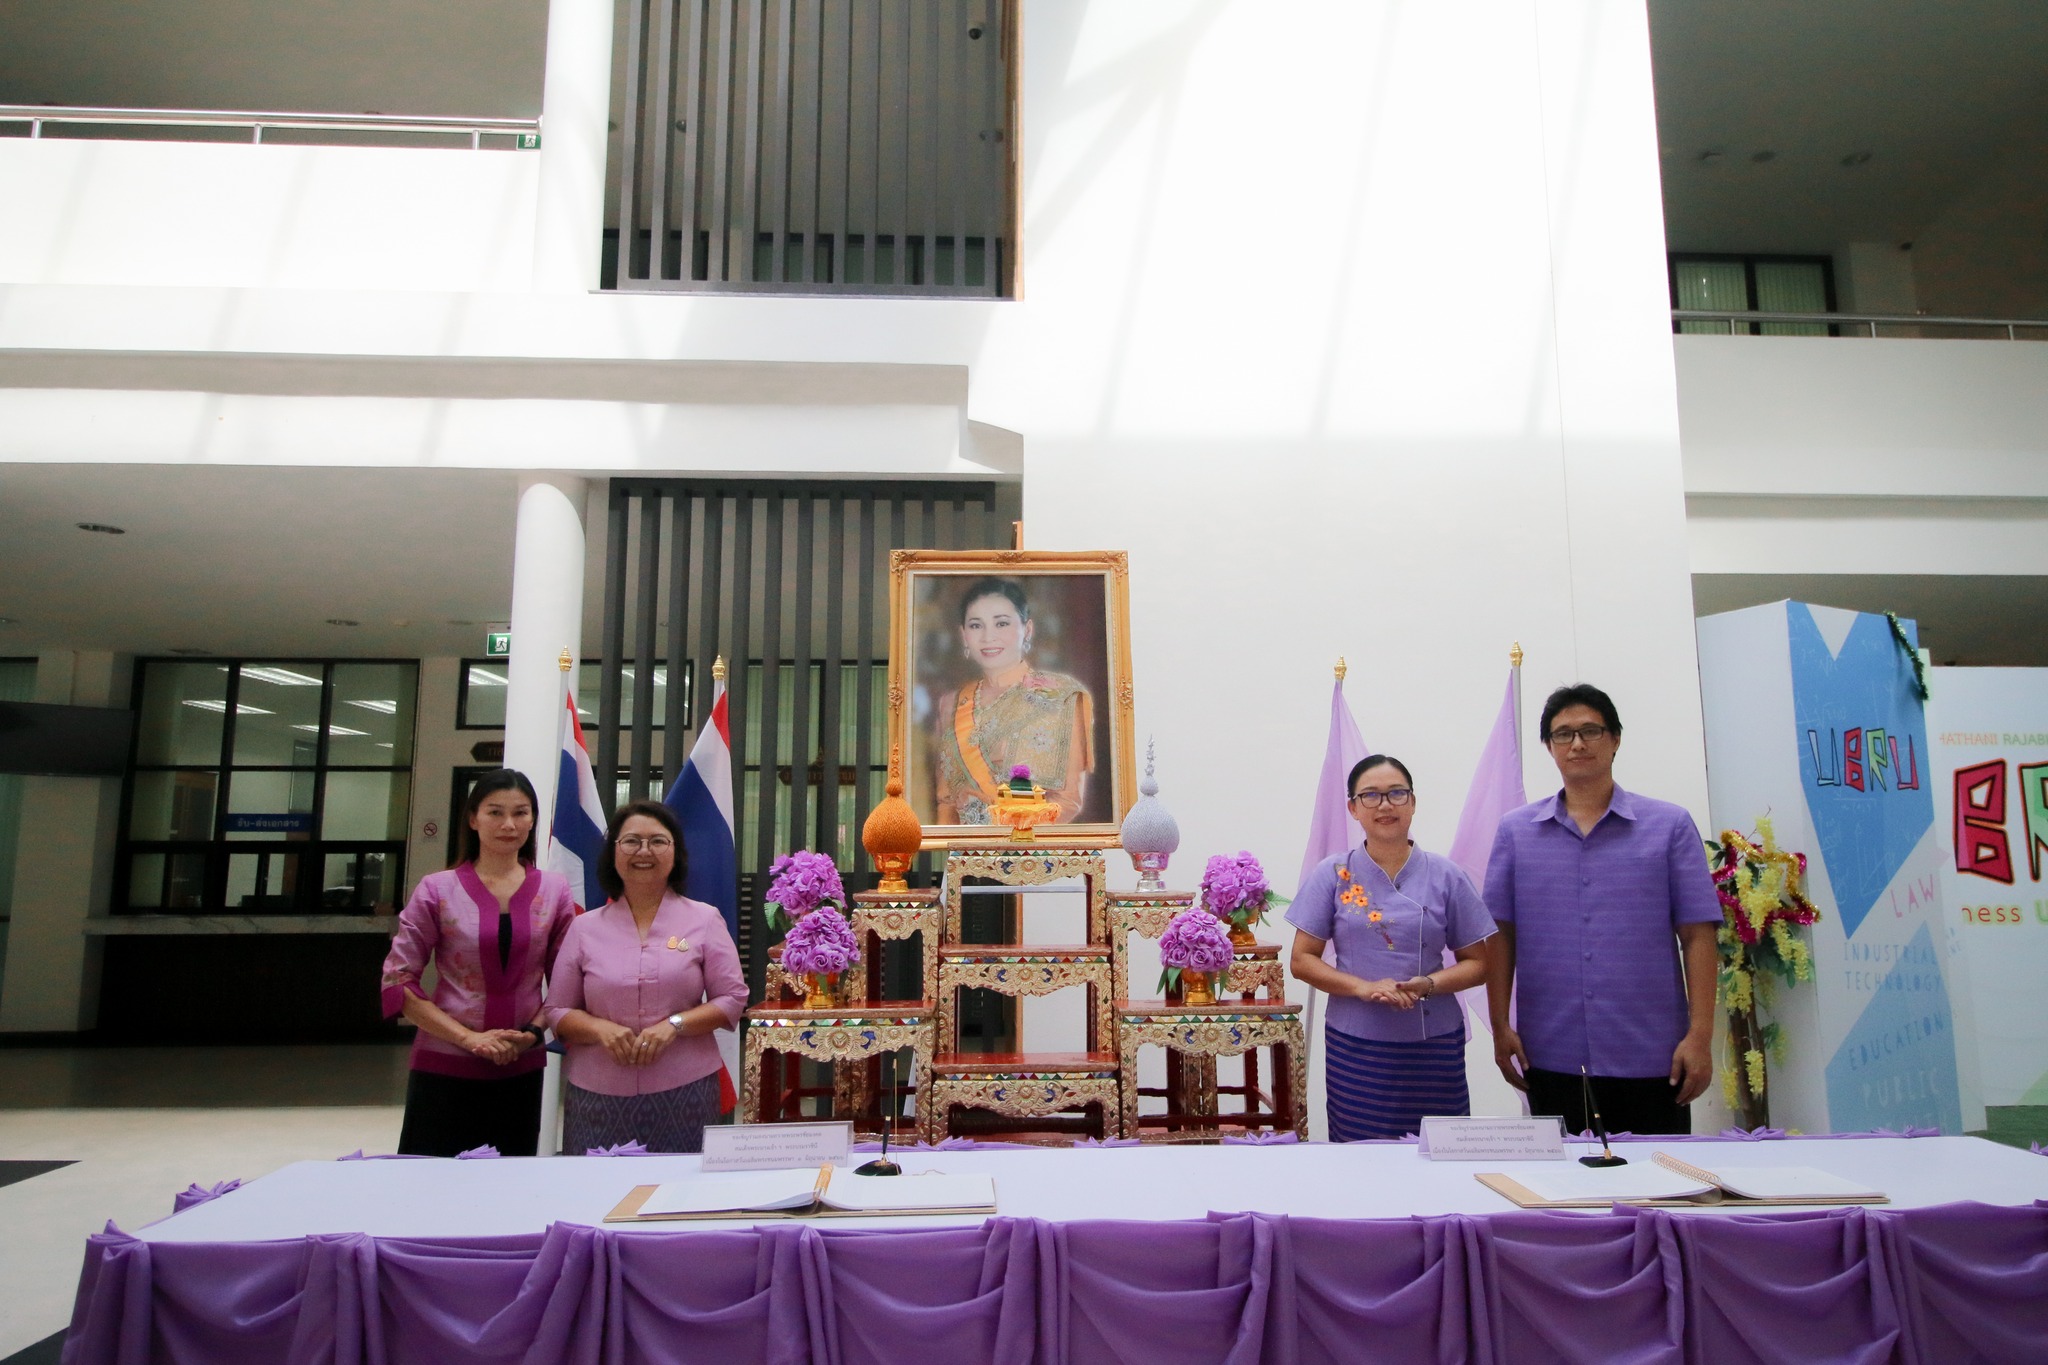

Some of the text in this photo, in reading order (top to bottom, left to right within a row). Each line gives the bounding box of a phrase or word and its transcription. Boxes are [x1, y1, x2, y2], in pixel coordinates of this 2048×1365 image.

[2003, 733, 2048, 745] RAJAB
[1807, 726, 1919, 793] UBRU
[1889, 874, 1936, 920] LAW
[1843, 942, 1938, 965] INDUSTRIAL
[1844, 970, 1943, 992] TECHNOLOGY
[1847, 1011, 1944, 1071] EDUCATION
